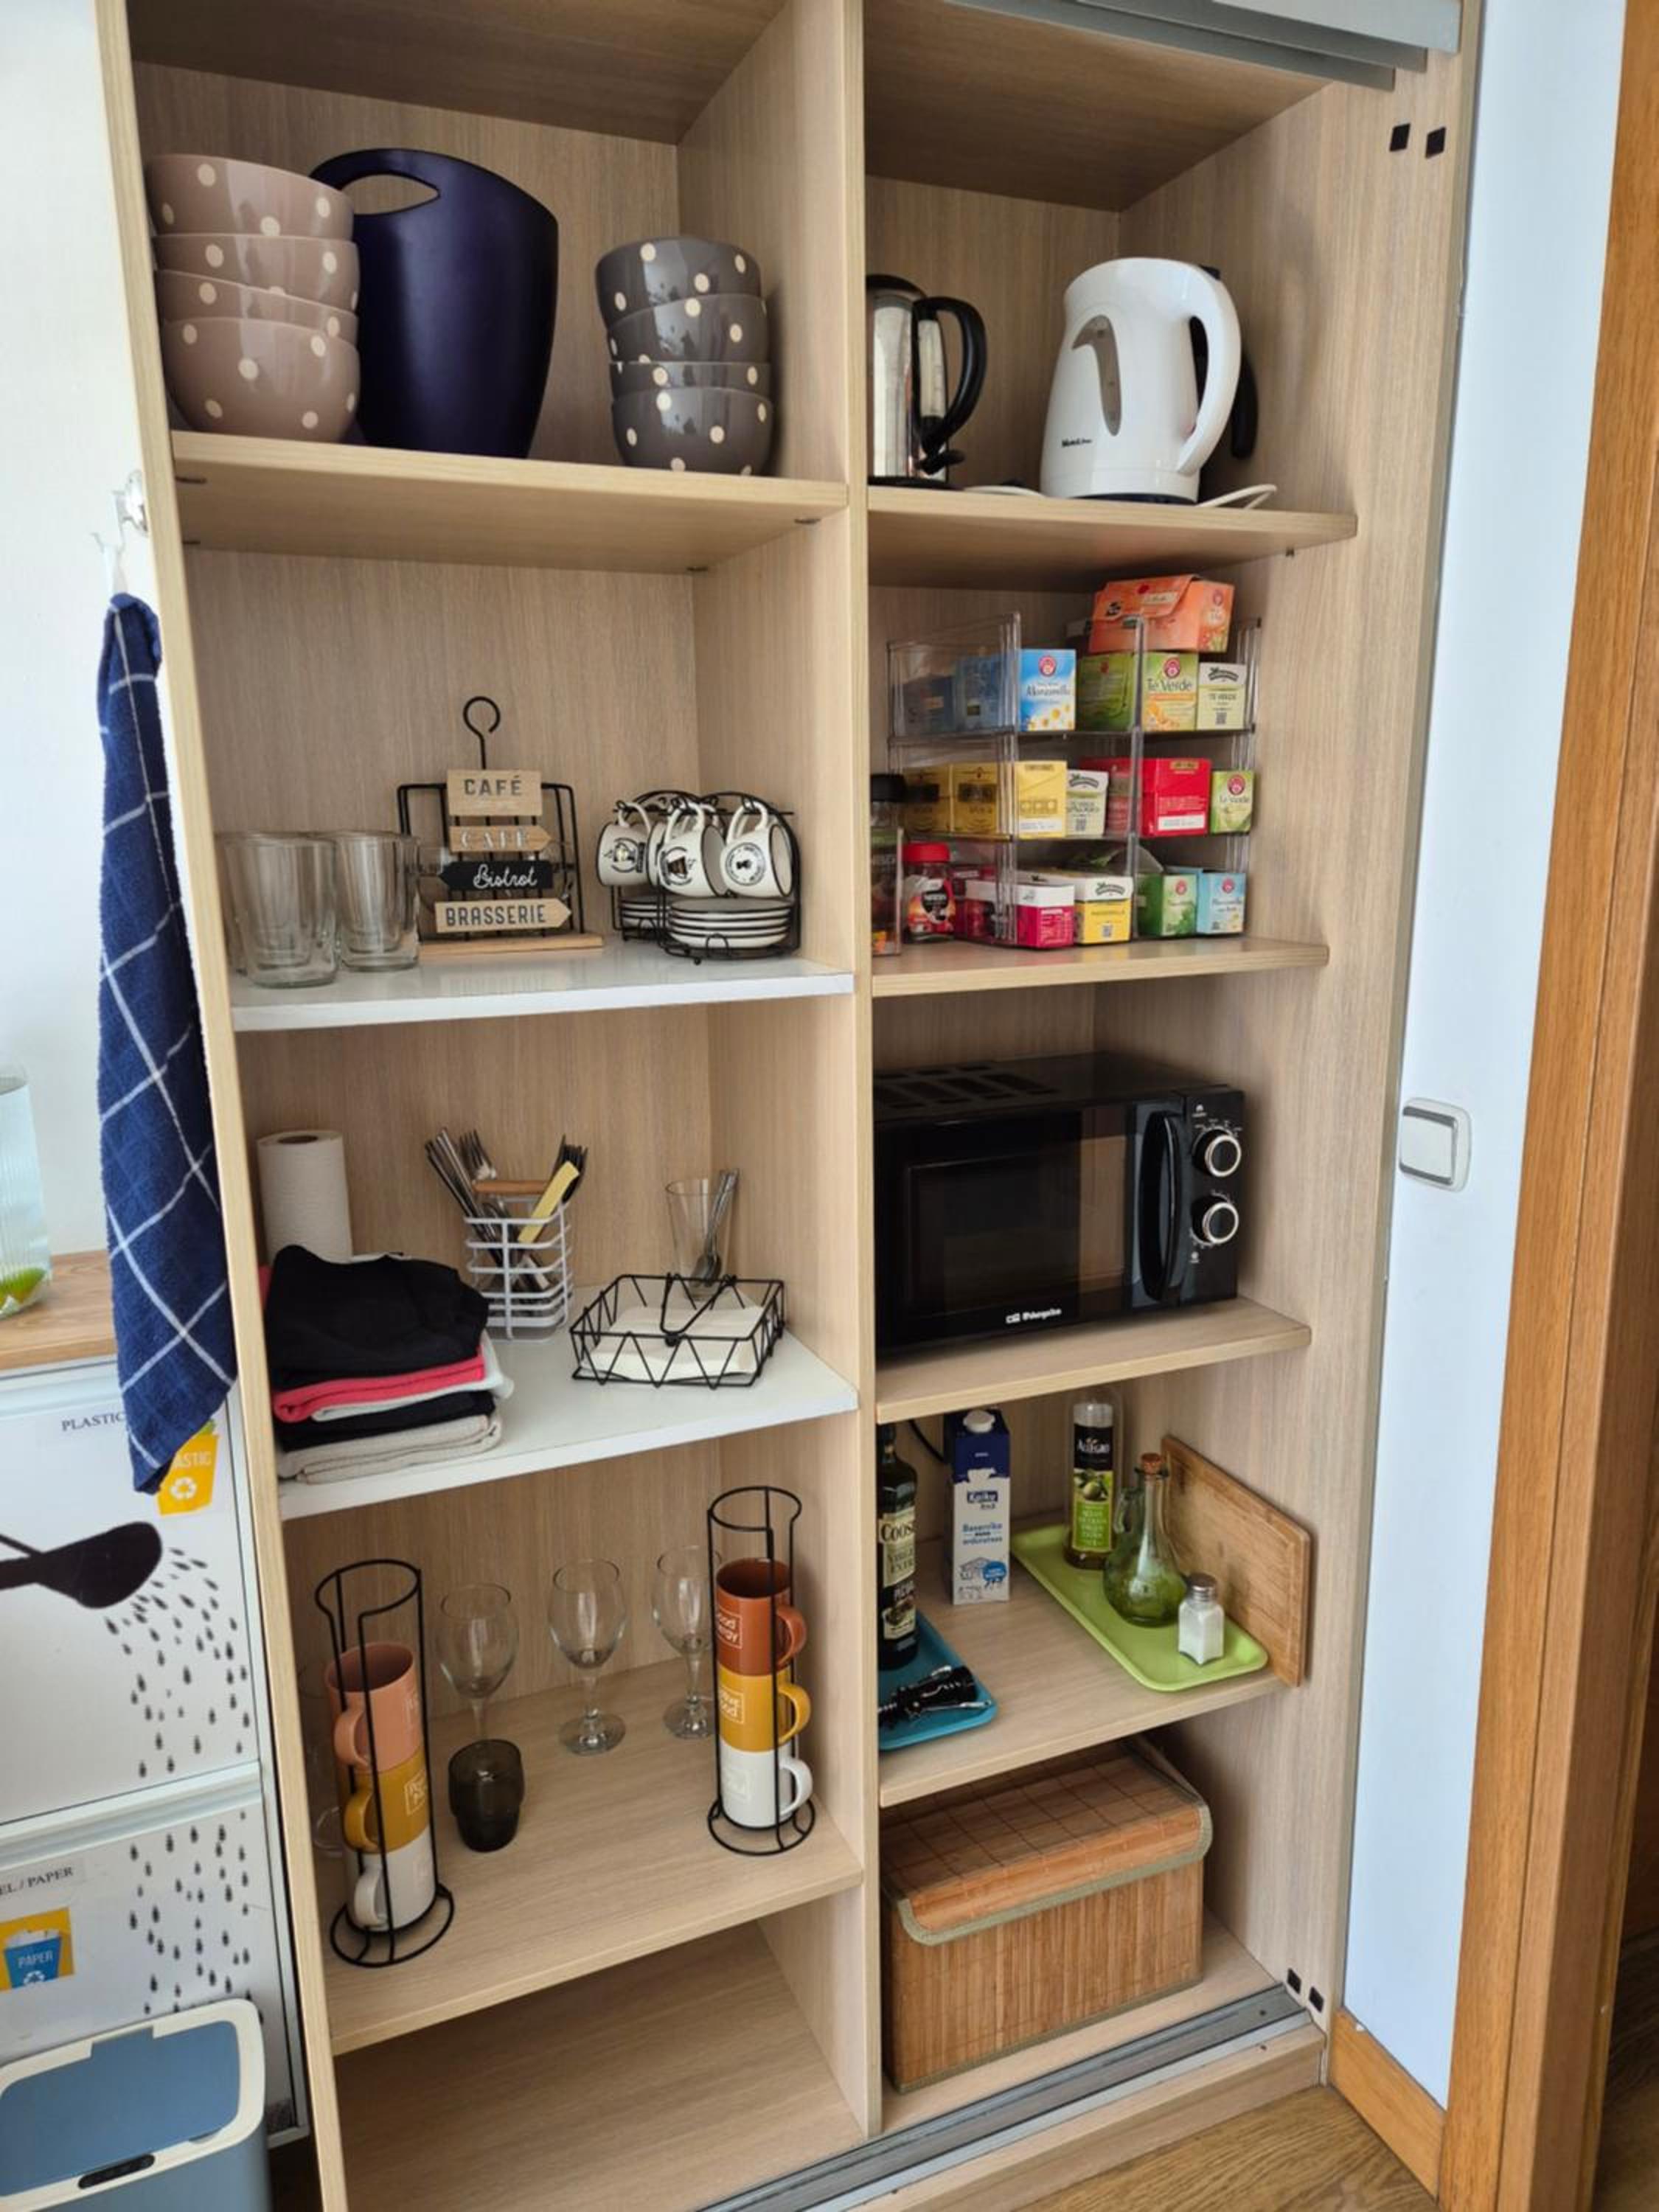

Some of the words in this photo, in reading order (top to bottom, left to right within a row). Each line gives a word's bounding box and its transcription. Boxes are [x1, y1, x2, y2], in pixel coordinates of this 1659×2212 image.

[464, 775, 522, 796] CAFÉ
[473, 863, 538, 889] Bistrot
[445, 905, 546, 927] BRASSERIE
[27, 1866, 73, 1888] PAPER
[18, 1950, 54, 1969] PAPER
